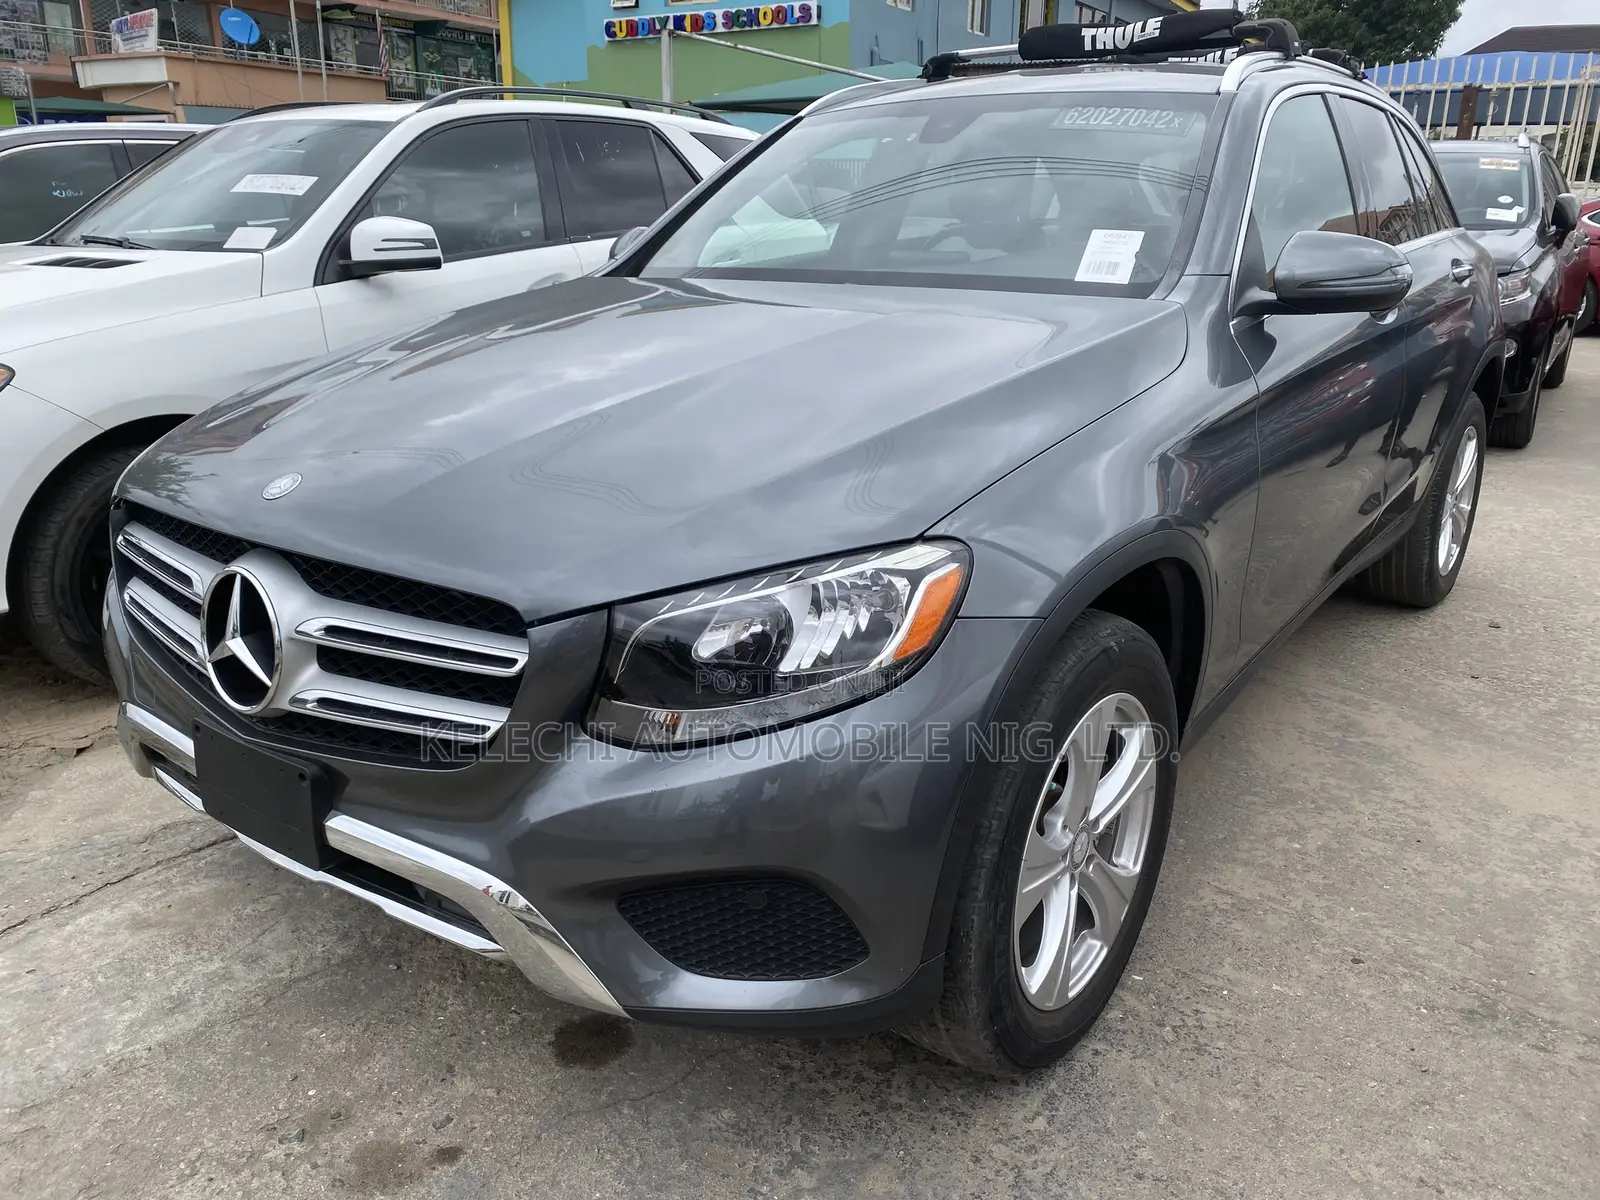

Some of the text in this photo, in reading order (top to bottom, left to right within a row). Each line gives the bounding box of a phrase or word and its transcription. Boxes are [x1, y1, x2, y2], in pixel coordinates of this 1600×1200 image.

[604, 3, 812, 39] CUDDLY KIDS SCHOOLS
[1081, 16, 1164, 51] THULE
